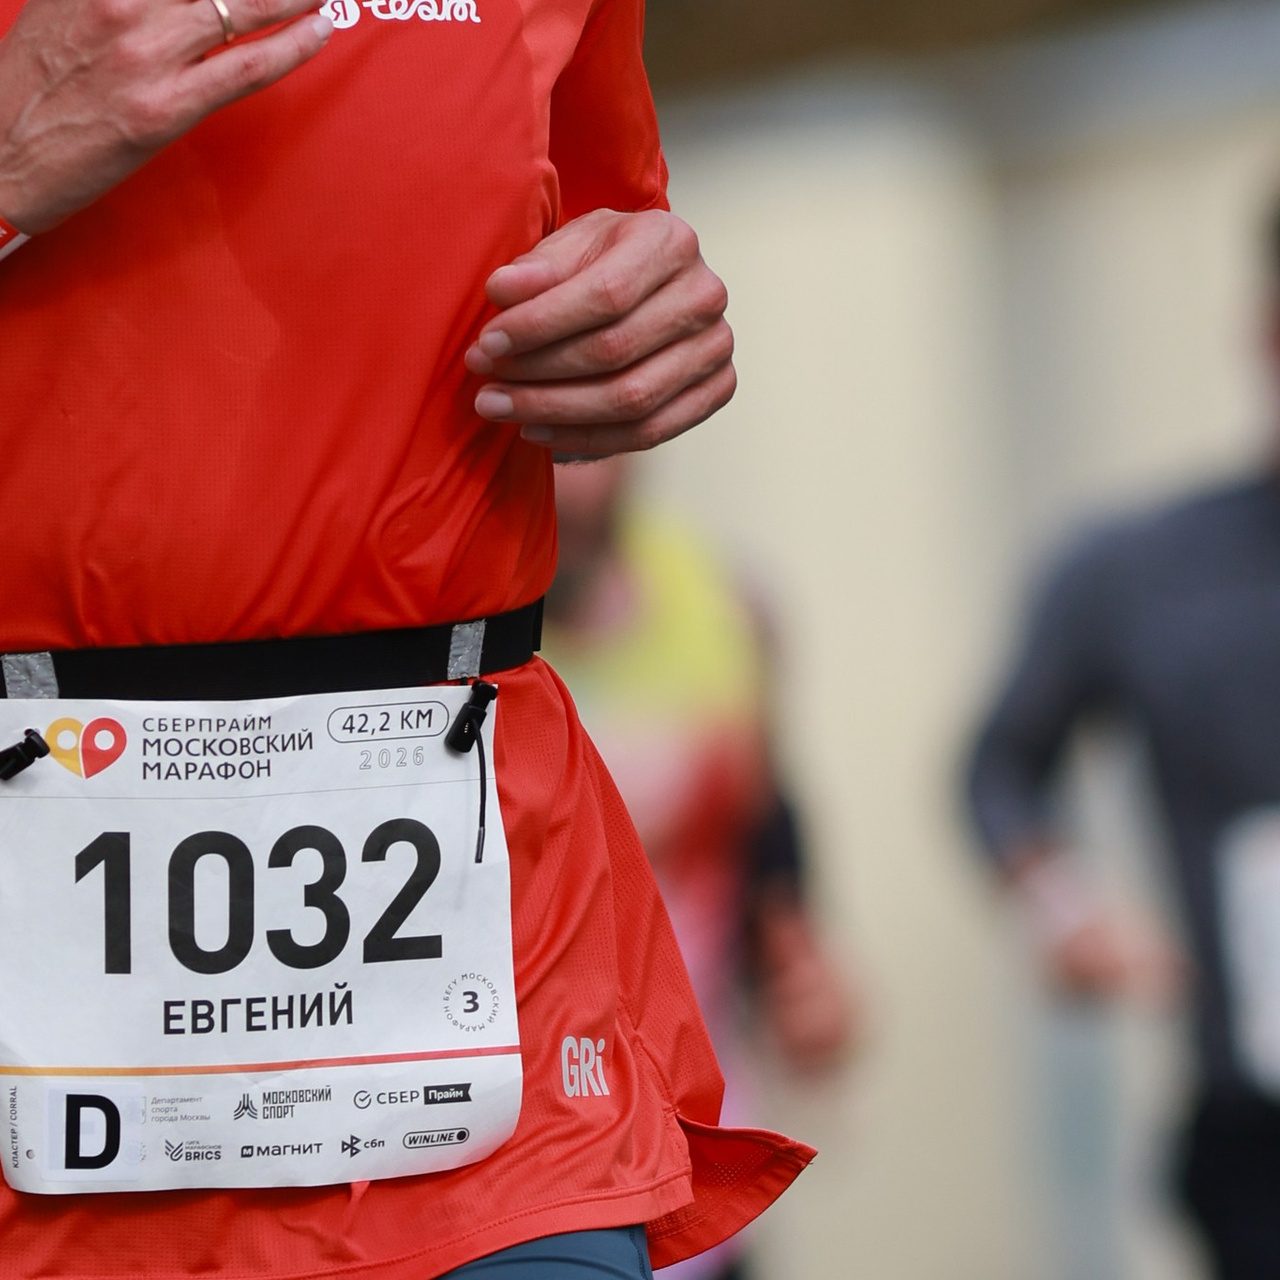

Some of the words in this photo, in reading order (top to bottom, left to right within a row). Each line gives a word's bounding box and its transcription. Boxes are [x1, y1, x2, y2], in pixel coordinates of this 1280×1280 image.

[142, 714, 272, 732] СБЕРПРАЙМ
[342, 711, 391, 736] 42,2
[400, 708, 434, 730] КМ
[142, 728, 314, 757] МОСКОВСКИЙ
[359, 746, 425, 770] 2026
[142, 759, 271, 781] МАРАФОН
[74, 817, 443, 975] 1032
[163, 982, 355, 1035] ЕВГЕНИЙ
[462, 990, 480, 1014] 3
[9, 1085, 18, 1121] CORRAL
[151, 1096, 203, 1105] Департамент
[262, 1085, 332, 1105] МОСКОВСКИЙ
[376, 1090, 420, 1105] СБЕР
[428, 1088, 464, 1101] Прайм
[151, 1106, 178, 1114] спорта
[151, 1115, 178, 1123] города
[262, 1104, 295, 1120] СПОРТ
[64, 1093, 121, 1170] D
[408, 1132, 456, 1146] WINLINE
[10, 1128, 19, 1169] КЛАСТЕР
[363, 1138, 386, 1149] сбп
[185, 1150, 222, 1161] BRICS
